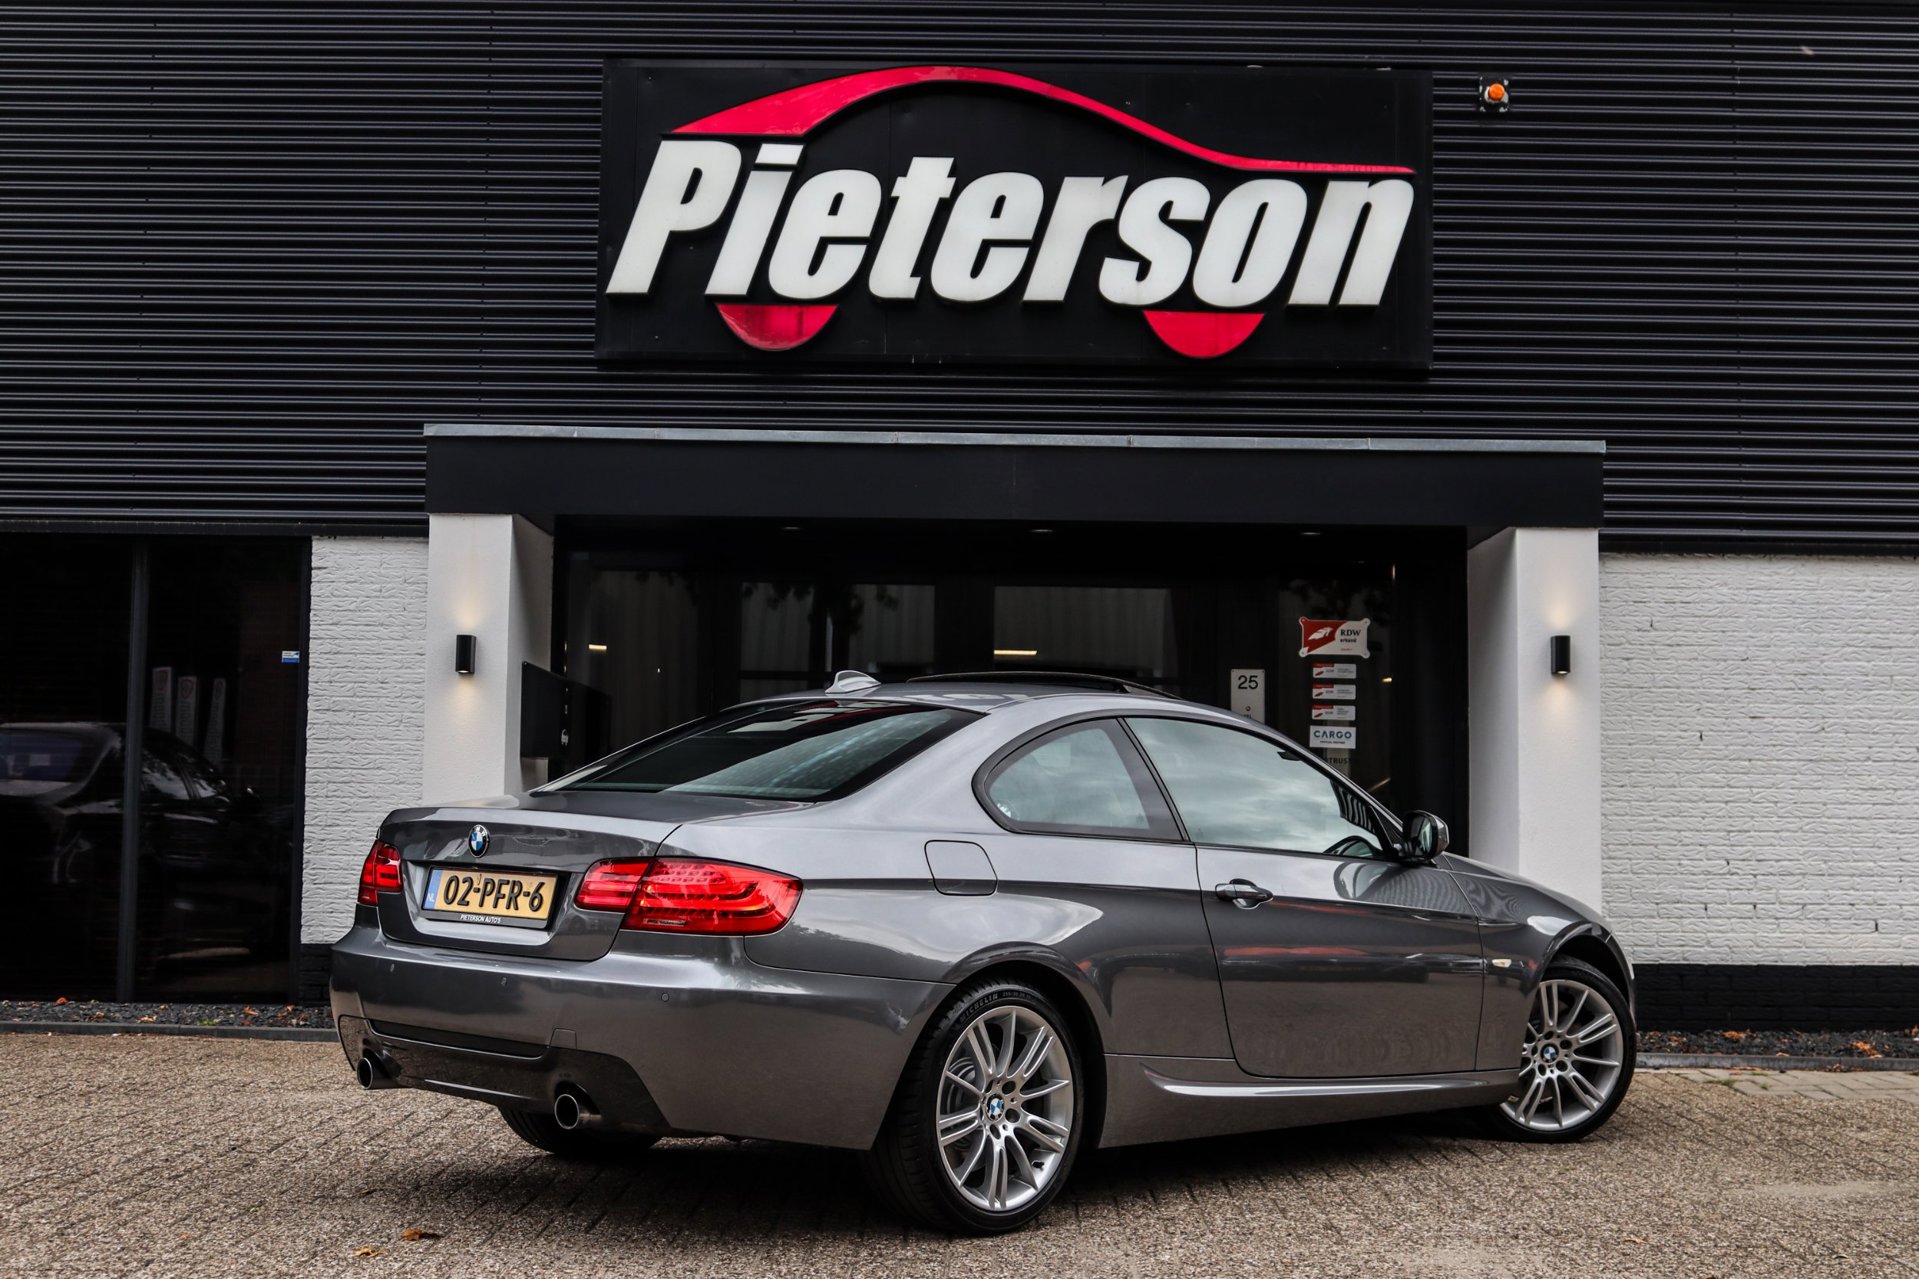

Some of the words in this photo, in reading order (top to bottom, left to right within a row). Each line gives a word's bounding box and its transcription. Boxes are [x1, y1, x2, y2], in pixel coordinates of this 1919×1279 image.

[605, 140, 1414, 308] Pieterson
[1238, 675, 1258, 690] 25
[1313, 730, 1352, 739] CARGO
[426, 892, 435, 902] NL
[443, 875, 546, 912] 02-PFR-6
[460, 914, 485, 922] PIETERSON
